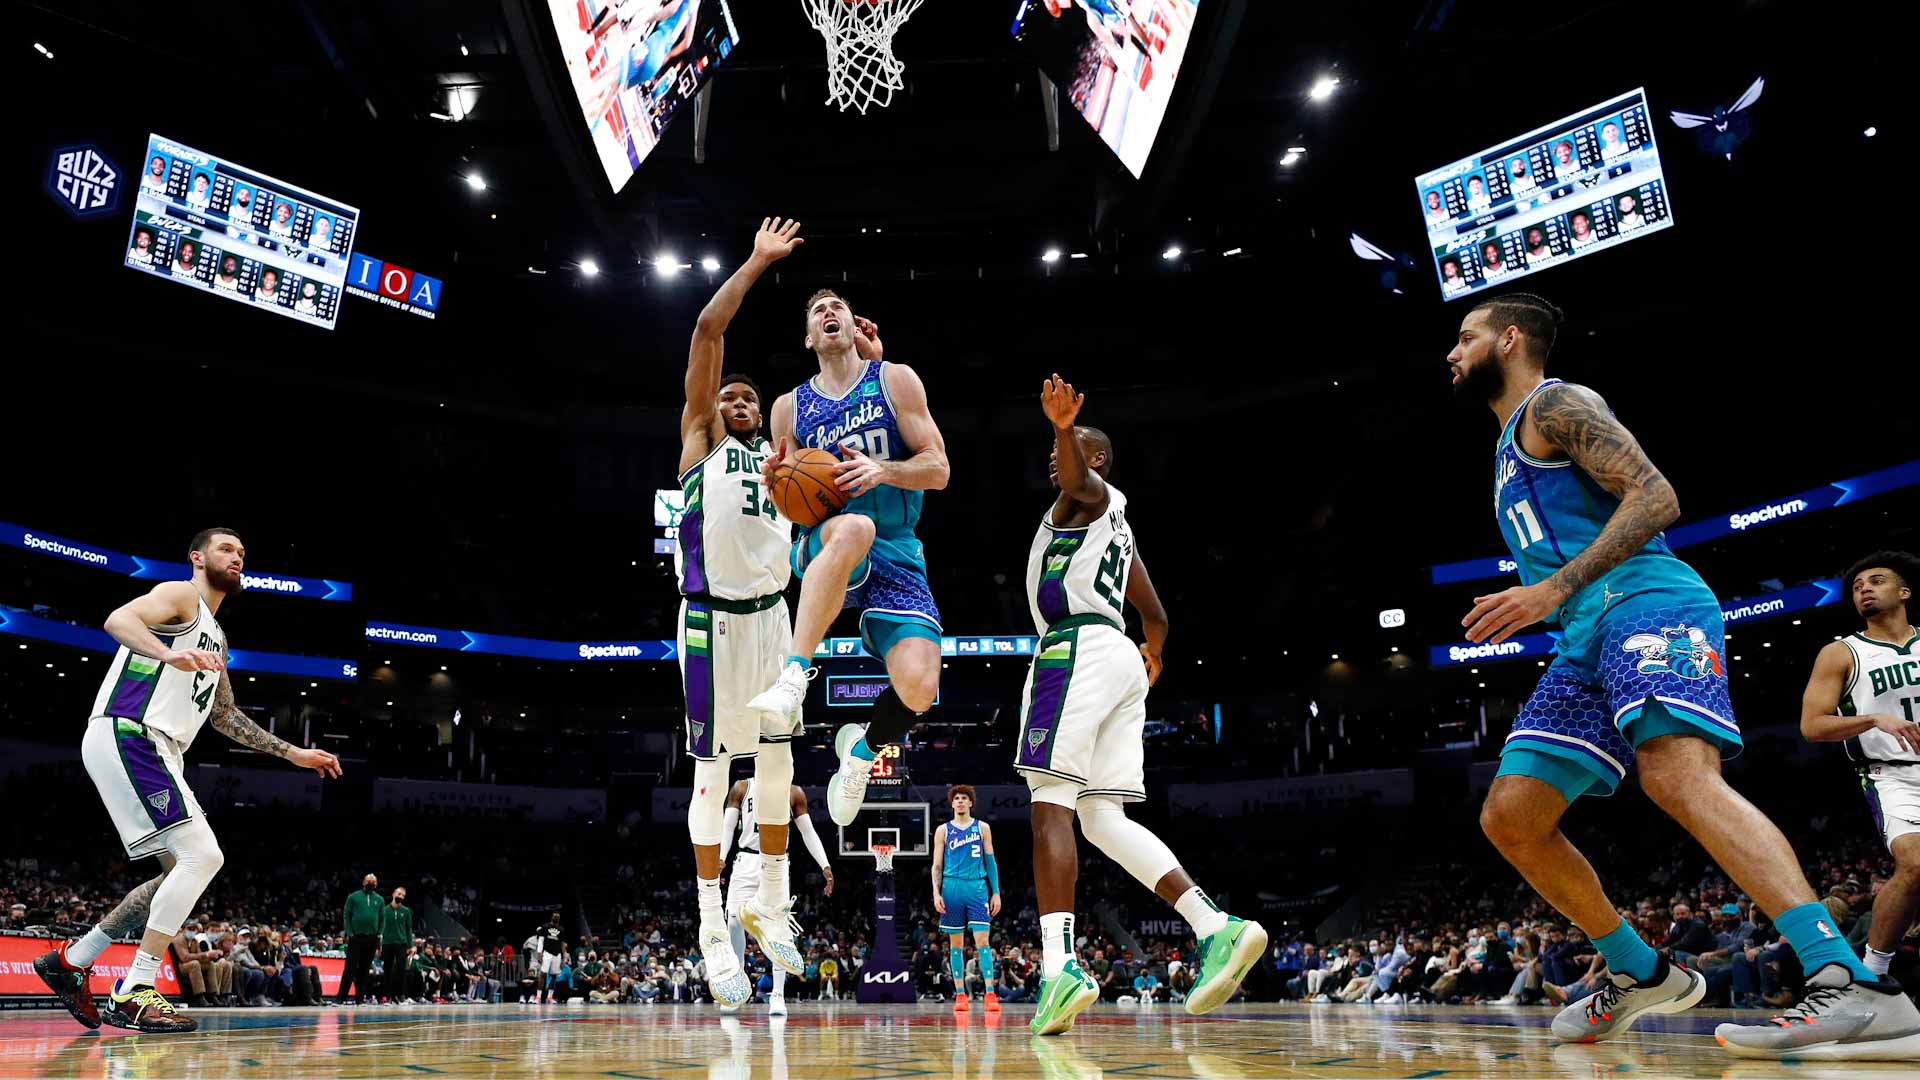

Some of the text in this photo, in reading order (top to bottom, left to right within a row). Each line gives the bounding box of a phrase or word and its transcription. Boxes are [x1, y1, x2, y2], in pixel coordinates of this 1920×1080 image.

[57, 149, 116, 188] BUZZ
[57, 173, 108, 209] CITY
[147, 216, 192, 234] BUCKS
[186, 214, 206, 224] STEALS
[345, 286, 435, 319] INSURANCE OFFICE OF AMERICA
[806, 400, 884, 450] Charlotte
[726, 448, 768, 474] BUC
[742, 480, 777, 520] 34
[1506, 499, 1544, 550] 11
[1730, 500, 1804, 530] Spectrum
[24, 534, 108, 565] Spectrum.com
[1382, 612, 1401, 624] CC
[1721, 599, 1784, 622] trum.com
[579, 644, 638, 660] Spectrum
[837, 642, 854, 654] 87
[960, 642, 978, 651] FLS
[994, 642, 1014, 651] TOL
[1449, 641, 1520, 662] Spectrum
[1868, 660, 1920, 698] BUC
[192, 671, 214, 713] 54
[950, 832, 980, 850] Charlotte
[972, 845, 980, 857] 2
[1139, 920, 1182, 936] HIVE
[864, 972, 909, 983] KIA
